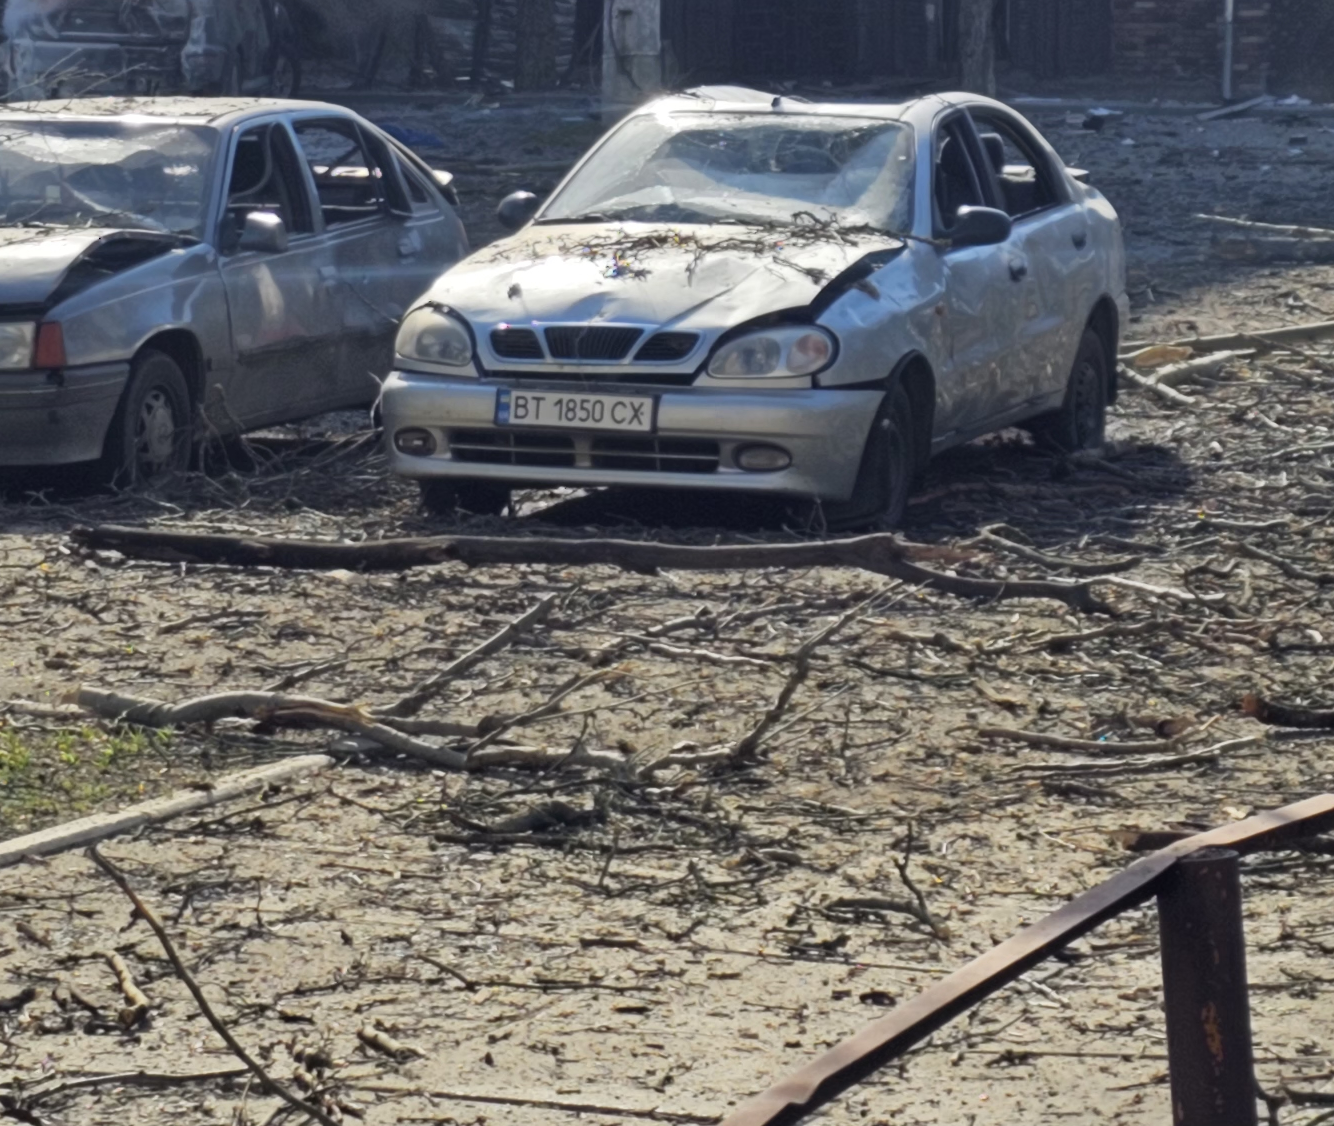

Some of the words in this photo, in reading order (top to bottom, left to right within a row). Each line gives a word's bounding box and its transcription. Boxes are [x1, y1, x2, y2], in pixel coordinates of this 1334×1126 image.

[514, 395, 545, 420] BT
[554, 398, 605, 423] 1850
[611, 401, 644, 426] CX
